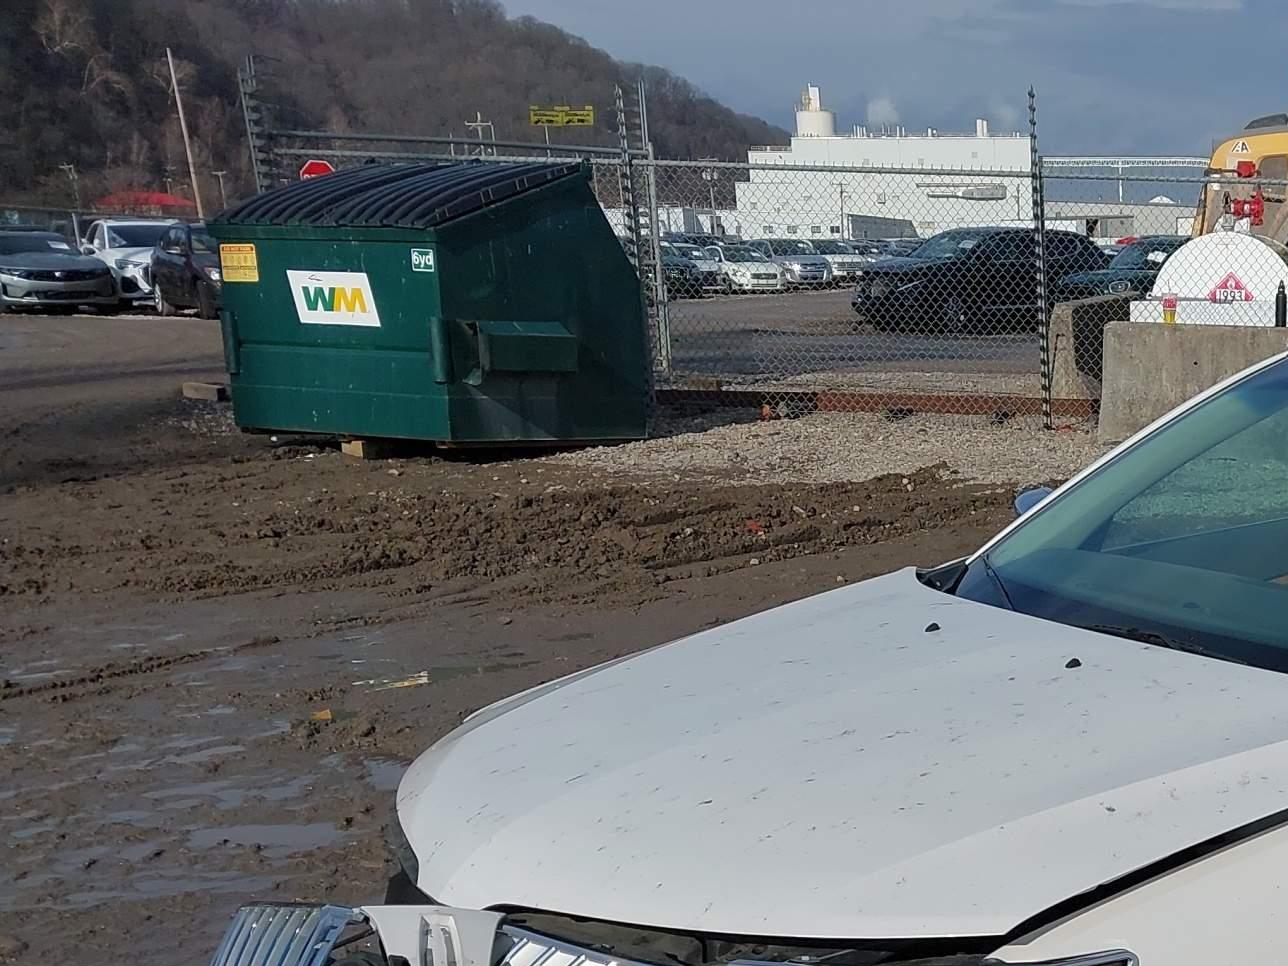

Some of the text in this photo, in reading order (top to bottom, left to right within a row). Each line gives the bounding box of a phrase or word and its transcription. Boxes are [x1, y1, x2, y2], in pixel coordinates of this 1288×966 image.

[413, 251, 432, 268] 6yd
[301, 285, 368, 313] WM
[1218, 290, 1243, 303] 1993
